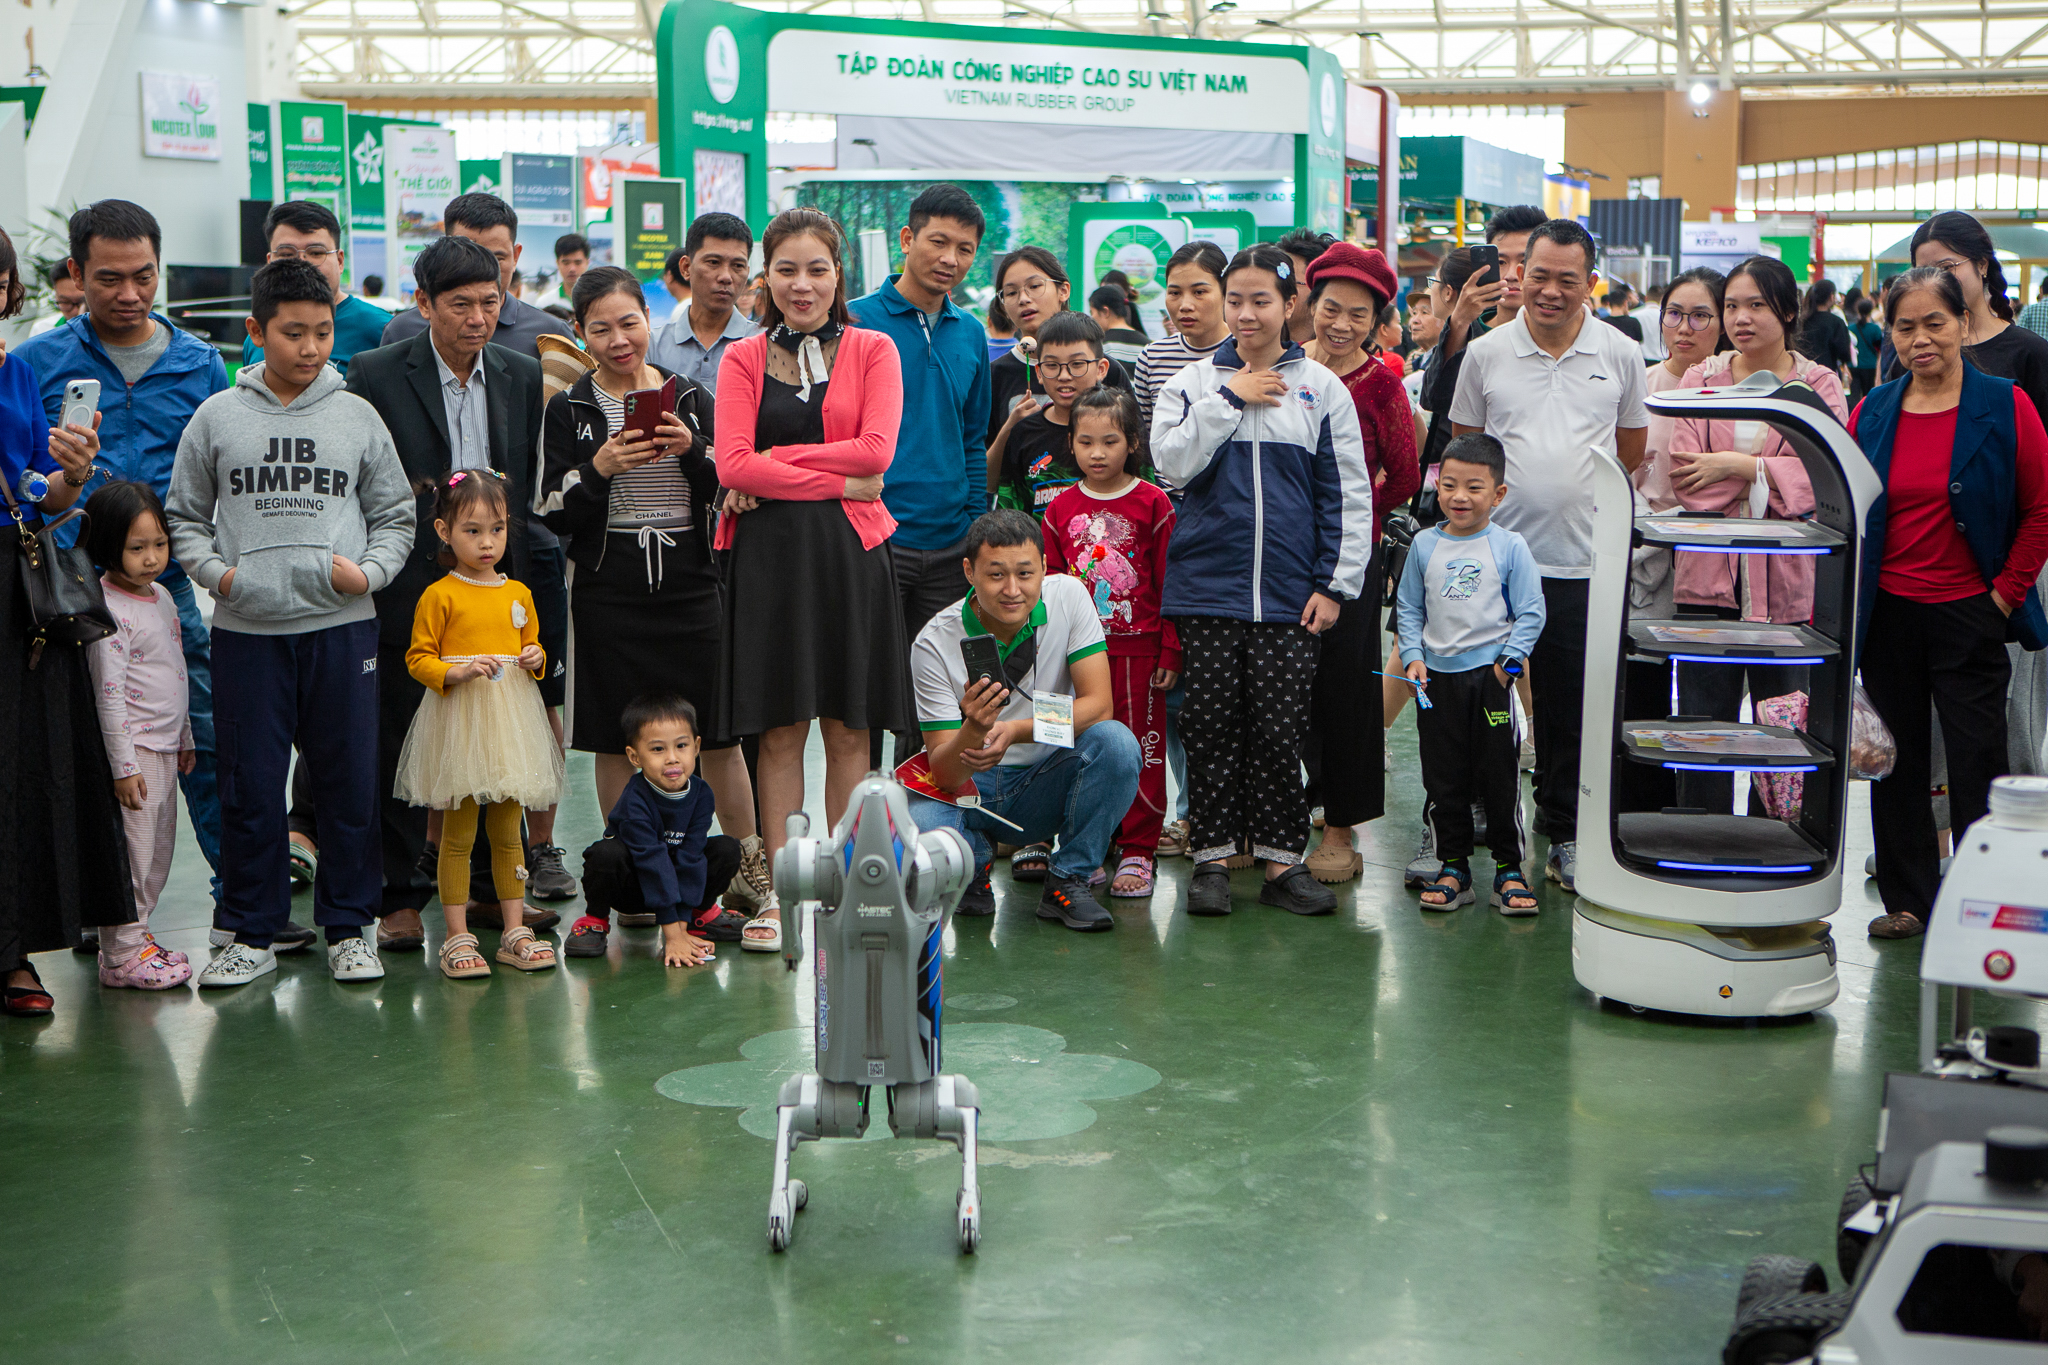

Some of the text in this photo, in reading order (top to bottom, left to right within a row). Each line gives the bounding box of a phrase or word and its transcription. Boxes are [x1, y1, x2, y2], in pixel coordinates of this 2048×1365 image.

[836, 51, 1249, 96] TẬP ĐOÀN CÔNG NGHIỆP CAO SU VIỆT NAM
[944, 89, 1136, 112] VIETNAM RUBBER GROUP
[151, 118, 191, 137] NICOTEX
[399, 173, 453, 190] THẾ GIỚI
[262, 437, 317, 464] JIB
[229, 465, 349, 498] SIMPER
[255, 497, 324, 511] BEGINNING
[635, 511, 674, 520] CHANEL
[1140, 730, 1163, 769] Girl
[818, 947, 830, 1052] www.astec.vn
